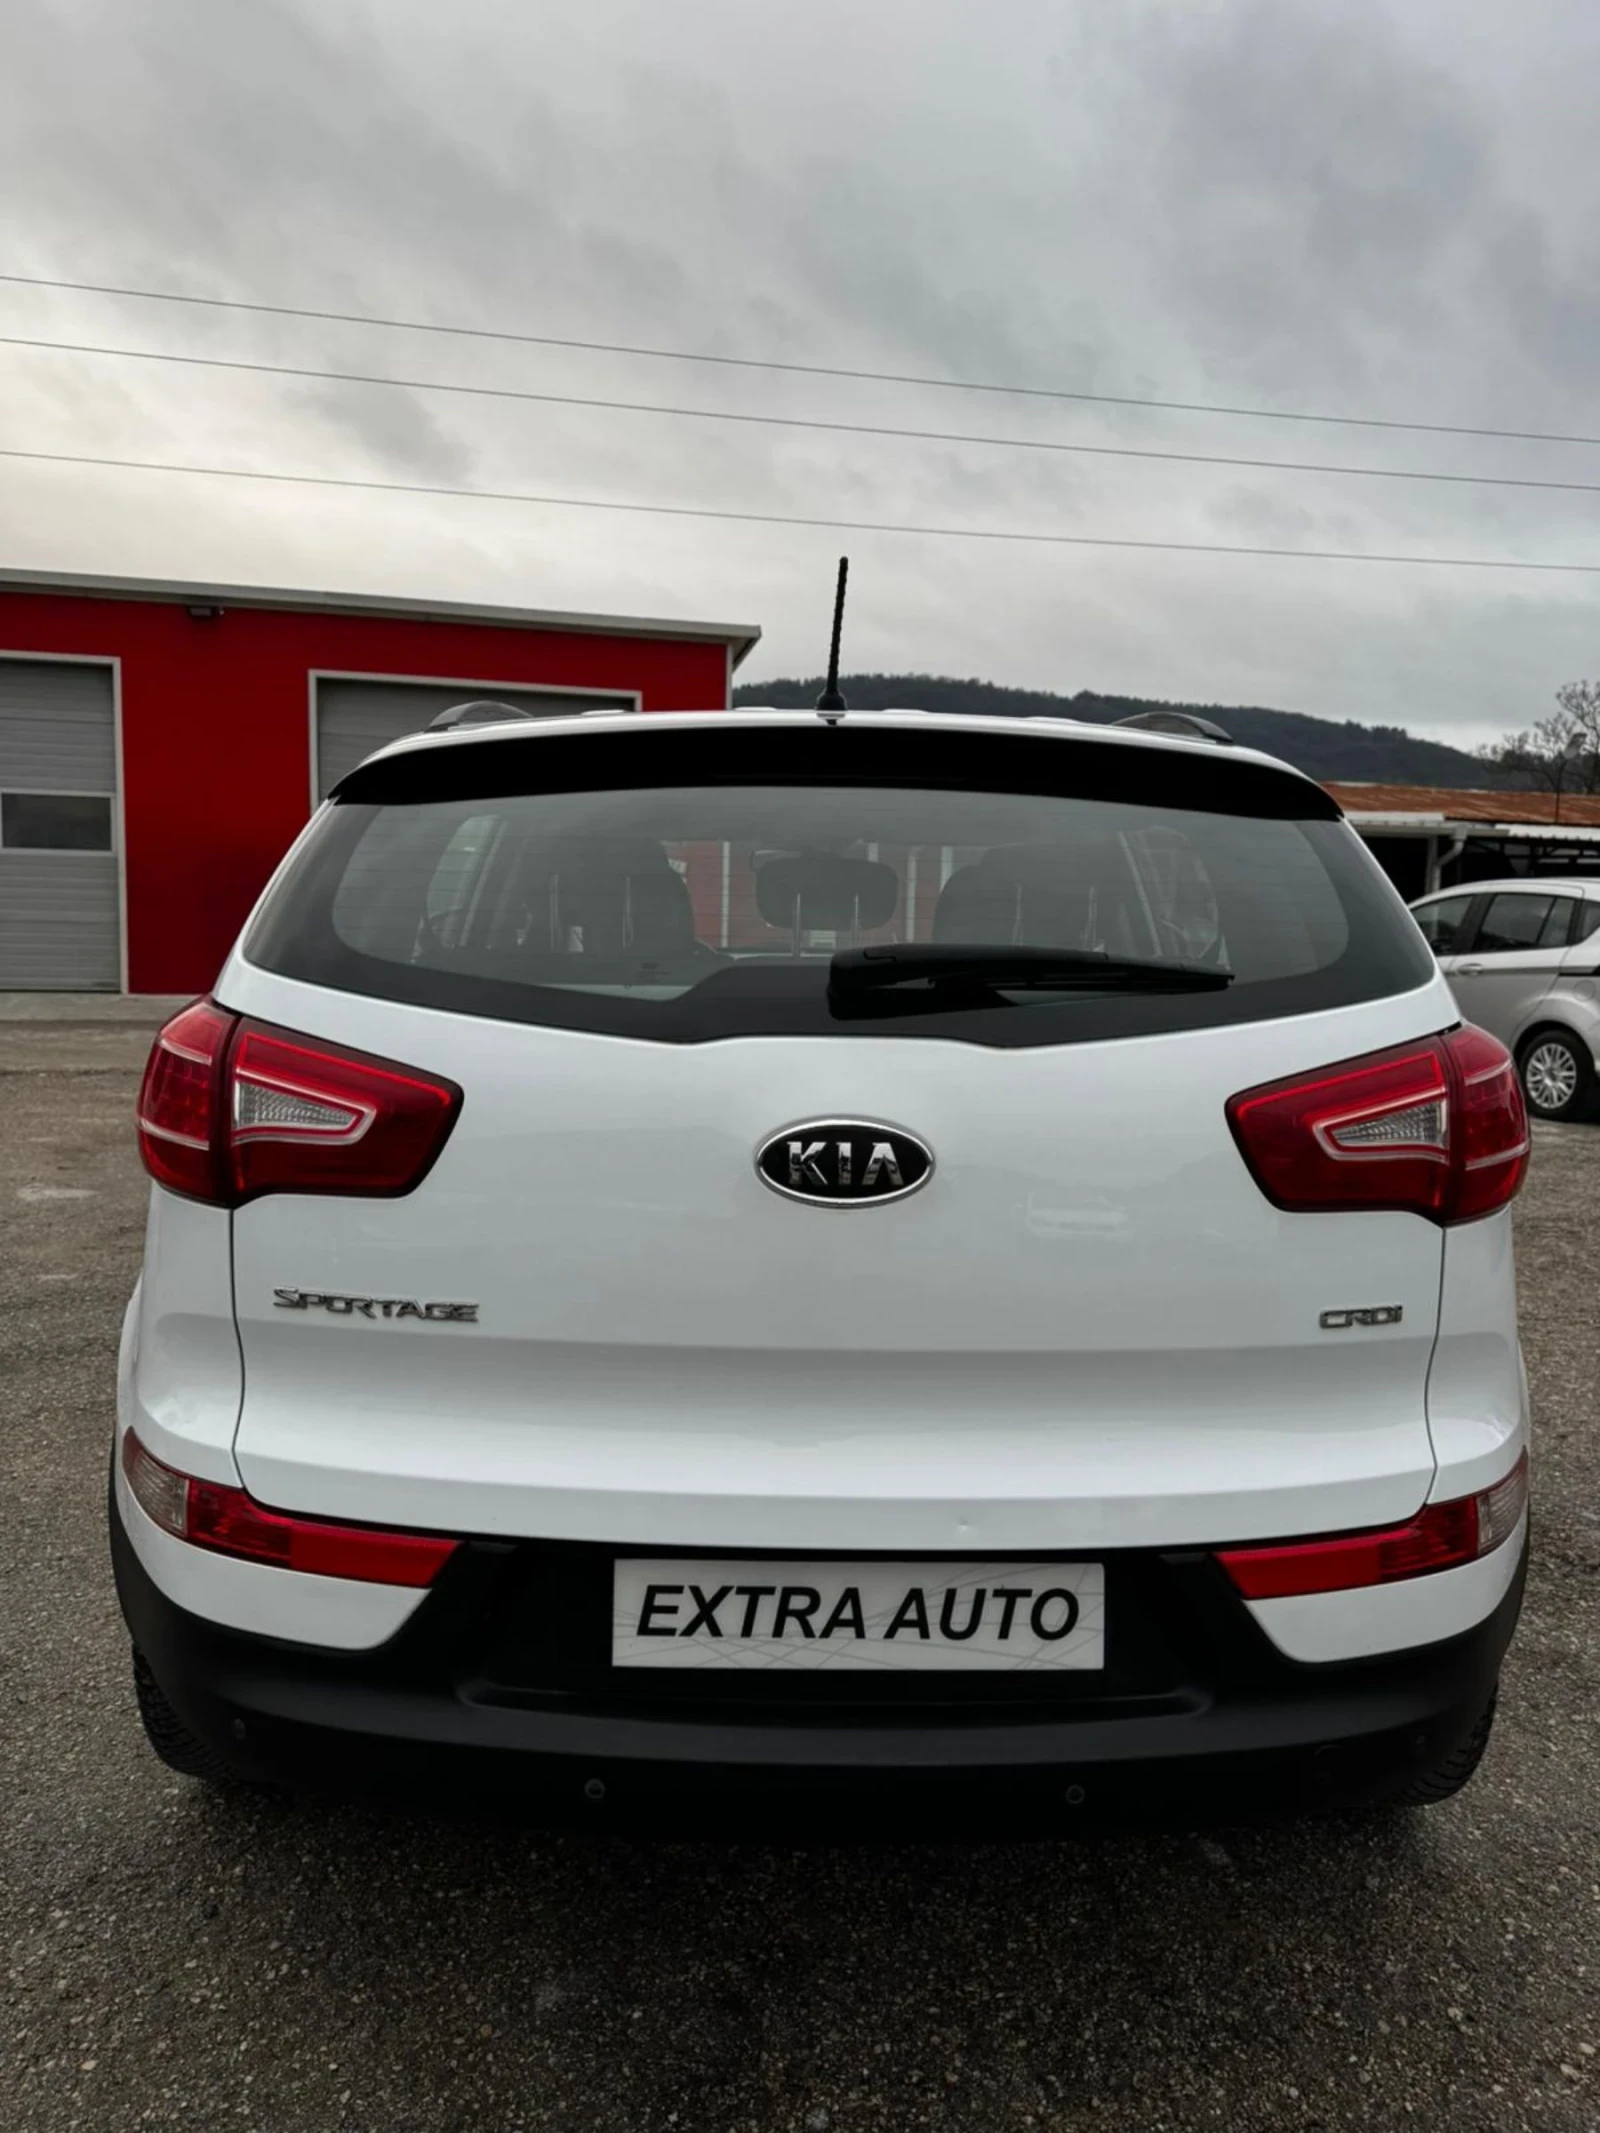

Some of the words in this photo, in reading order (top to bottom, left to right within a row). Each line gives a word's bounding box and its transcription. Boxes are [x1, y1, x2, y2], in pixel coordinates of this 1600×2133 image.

[787, 1141, 904, 1185] KIA
[273, 1287, 479, 1323] SPORTAGE
[636, 1584, 867, 1639] EXTRA
[883, 1587, 1080, 1641] AUTO
